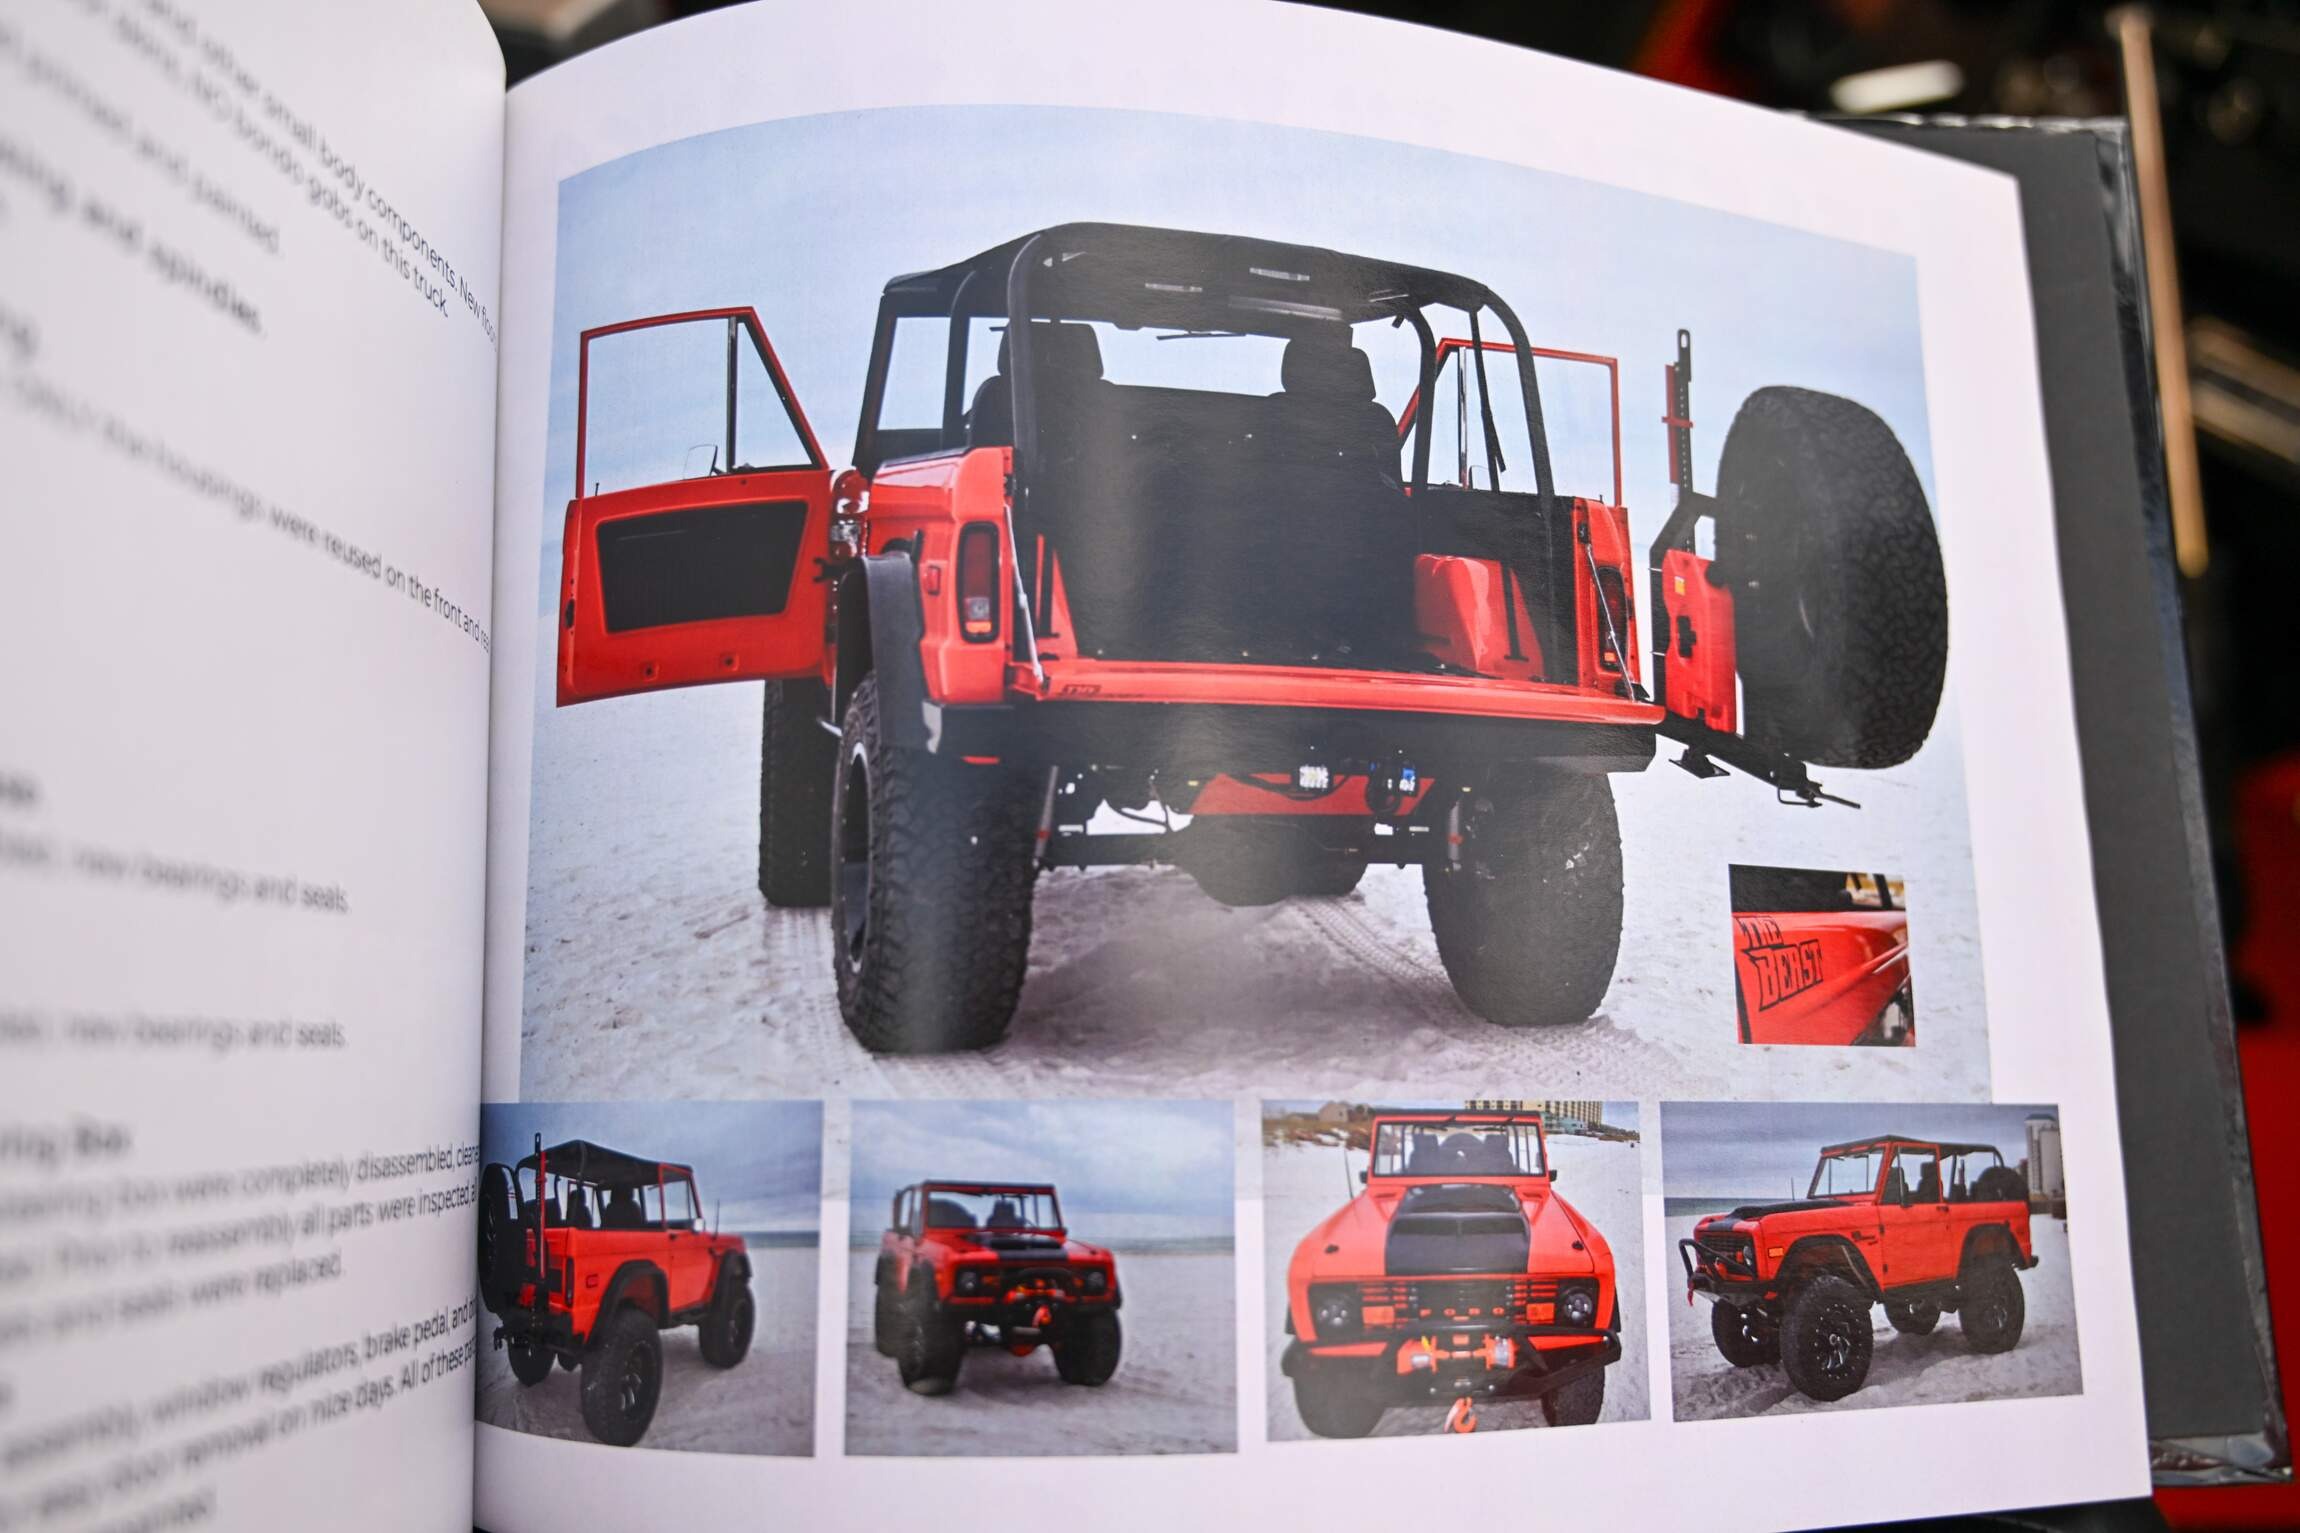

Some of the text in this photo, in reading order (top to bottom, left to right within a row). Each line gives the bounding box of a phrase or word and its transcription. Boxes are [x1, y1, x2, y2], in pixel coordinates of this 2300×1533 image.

[265, 95, 318, 152] small
[318, 138, 366, 203] body
[367, 188, 459, 292] components.
[459, 275, 480, 319] New
[357, 217, 379, 252] on
[382, 237, 410, 280] this
[323, 530, 382, 580] reused
[386, 566, 405, 592] on
[408, 575, 432, 608] the
[434, 587, 462, 628] front
[463, 614, 480, 642] and
[355, 1144, 456, 1184] disassembled,
[301, 1201, 326, 1237] all
[328, 1198, 374, 1238] parts
[377, 1196, 415, 1223] were
[419, 1181, 470, 1217] inspected,
[364, 1322, 411, 1360] brake
[413, 1306, 451, 1347] pedal,
[452, 1295, 469, 1329] and
[401, 1358, 420, 1393] All
[421, 1351, 436, 1384] of
[436, 1342, 463, 1375] these
